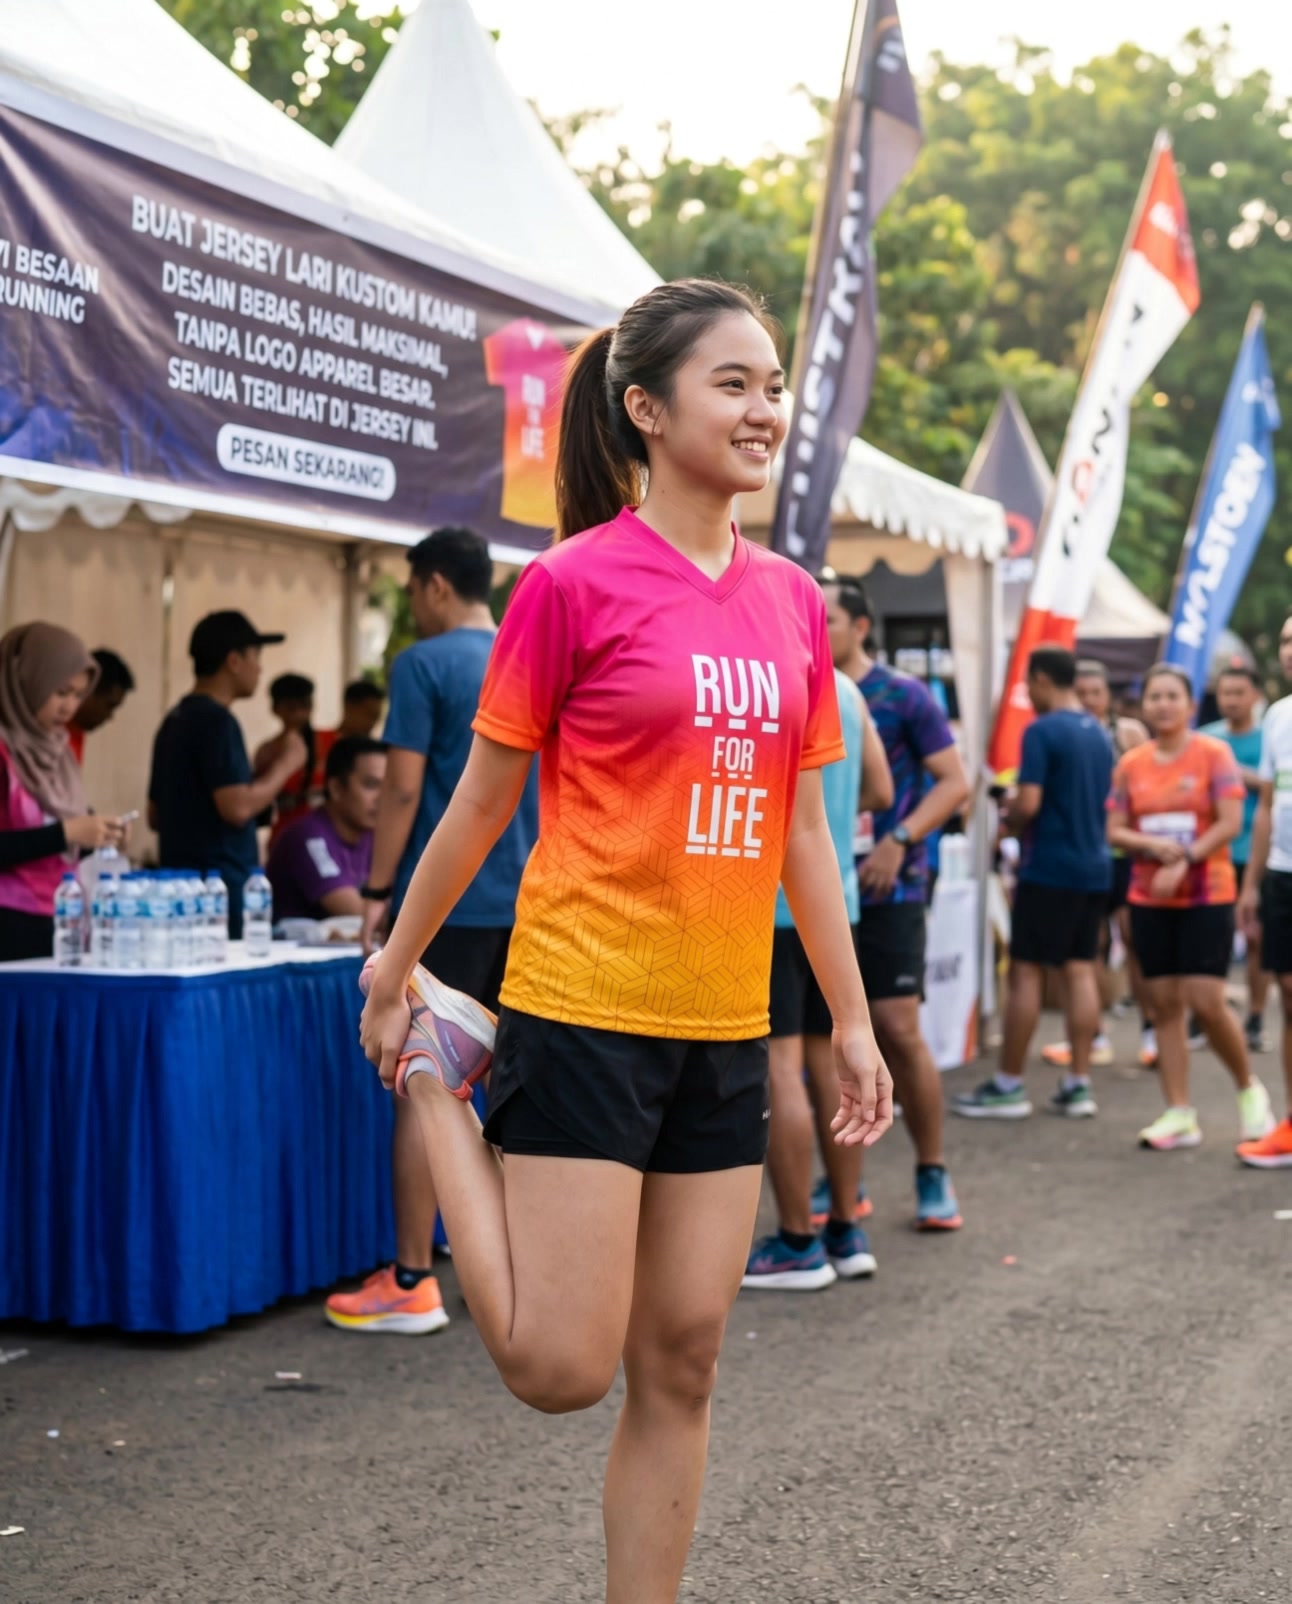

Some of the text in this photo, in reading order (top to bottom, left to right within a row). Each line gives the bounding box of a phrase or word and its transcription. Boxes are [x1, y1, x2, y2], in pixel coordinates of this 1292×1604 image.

[15, 244, 99, 294] BESAAN
[131, 195, 477, 341] BUAT JERSEY LARI KUSTOM KAMU!
[162, 261, 236, 312] DESAIN
[240, 284, 305, 337] BEBAS,
[308, 305, 359, 348] HASIL
[174, 311, 436, 410] TANPA LOGO APPAREL BESAR.
[168, 356, 238, 404] SEMUA
[241, 374, 328, 424] TERLIHAT
[329, 396, 349, 429] DI
[350, 402, 412, 444] JERSEY
[231, 436, 385, 490] PESAN SEKARANG!
[692, 654, 780, 719] RUN
[712, 736, 755, 772] FOR
[687, 783, 768, 848] LIFE
